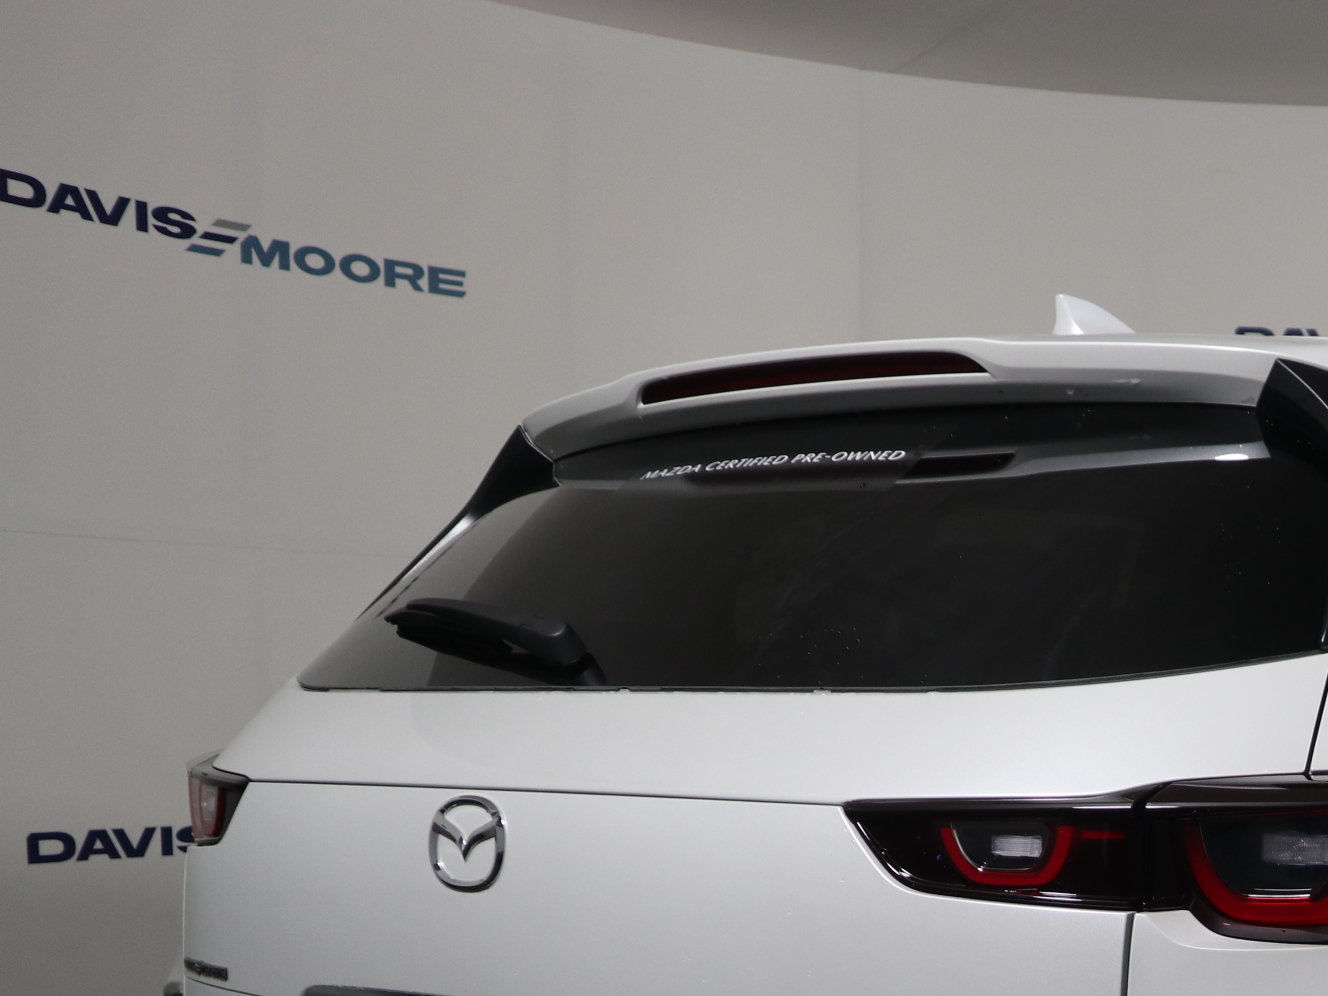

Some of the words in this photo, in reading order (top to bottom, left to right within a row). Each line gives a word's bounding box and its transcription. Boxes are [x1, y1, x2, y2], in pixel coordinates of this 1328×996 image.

[0, 168, 197, 241] DAVIS
[240, 235, 467, 298] MOORE
[640, 463, 704, 481] MAZDA
[704, 453, 789, 473] CERTIFIED
[791, 449, 907, 464] PRE-OWNED
